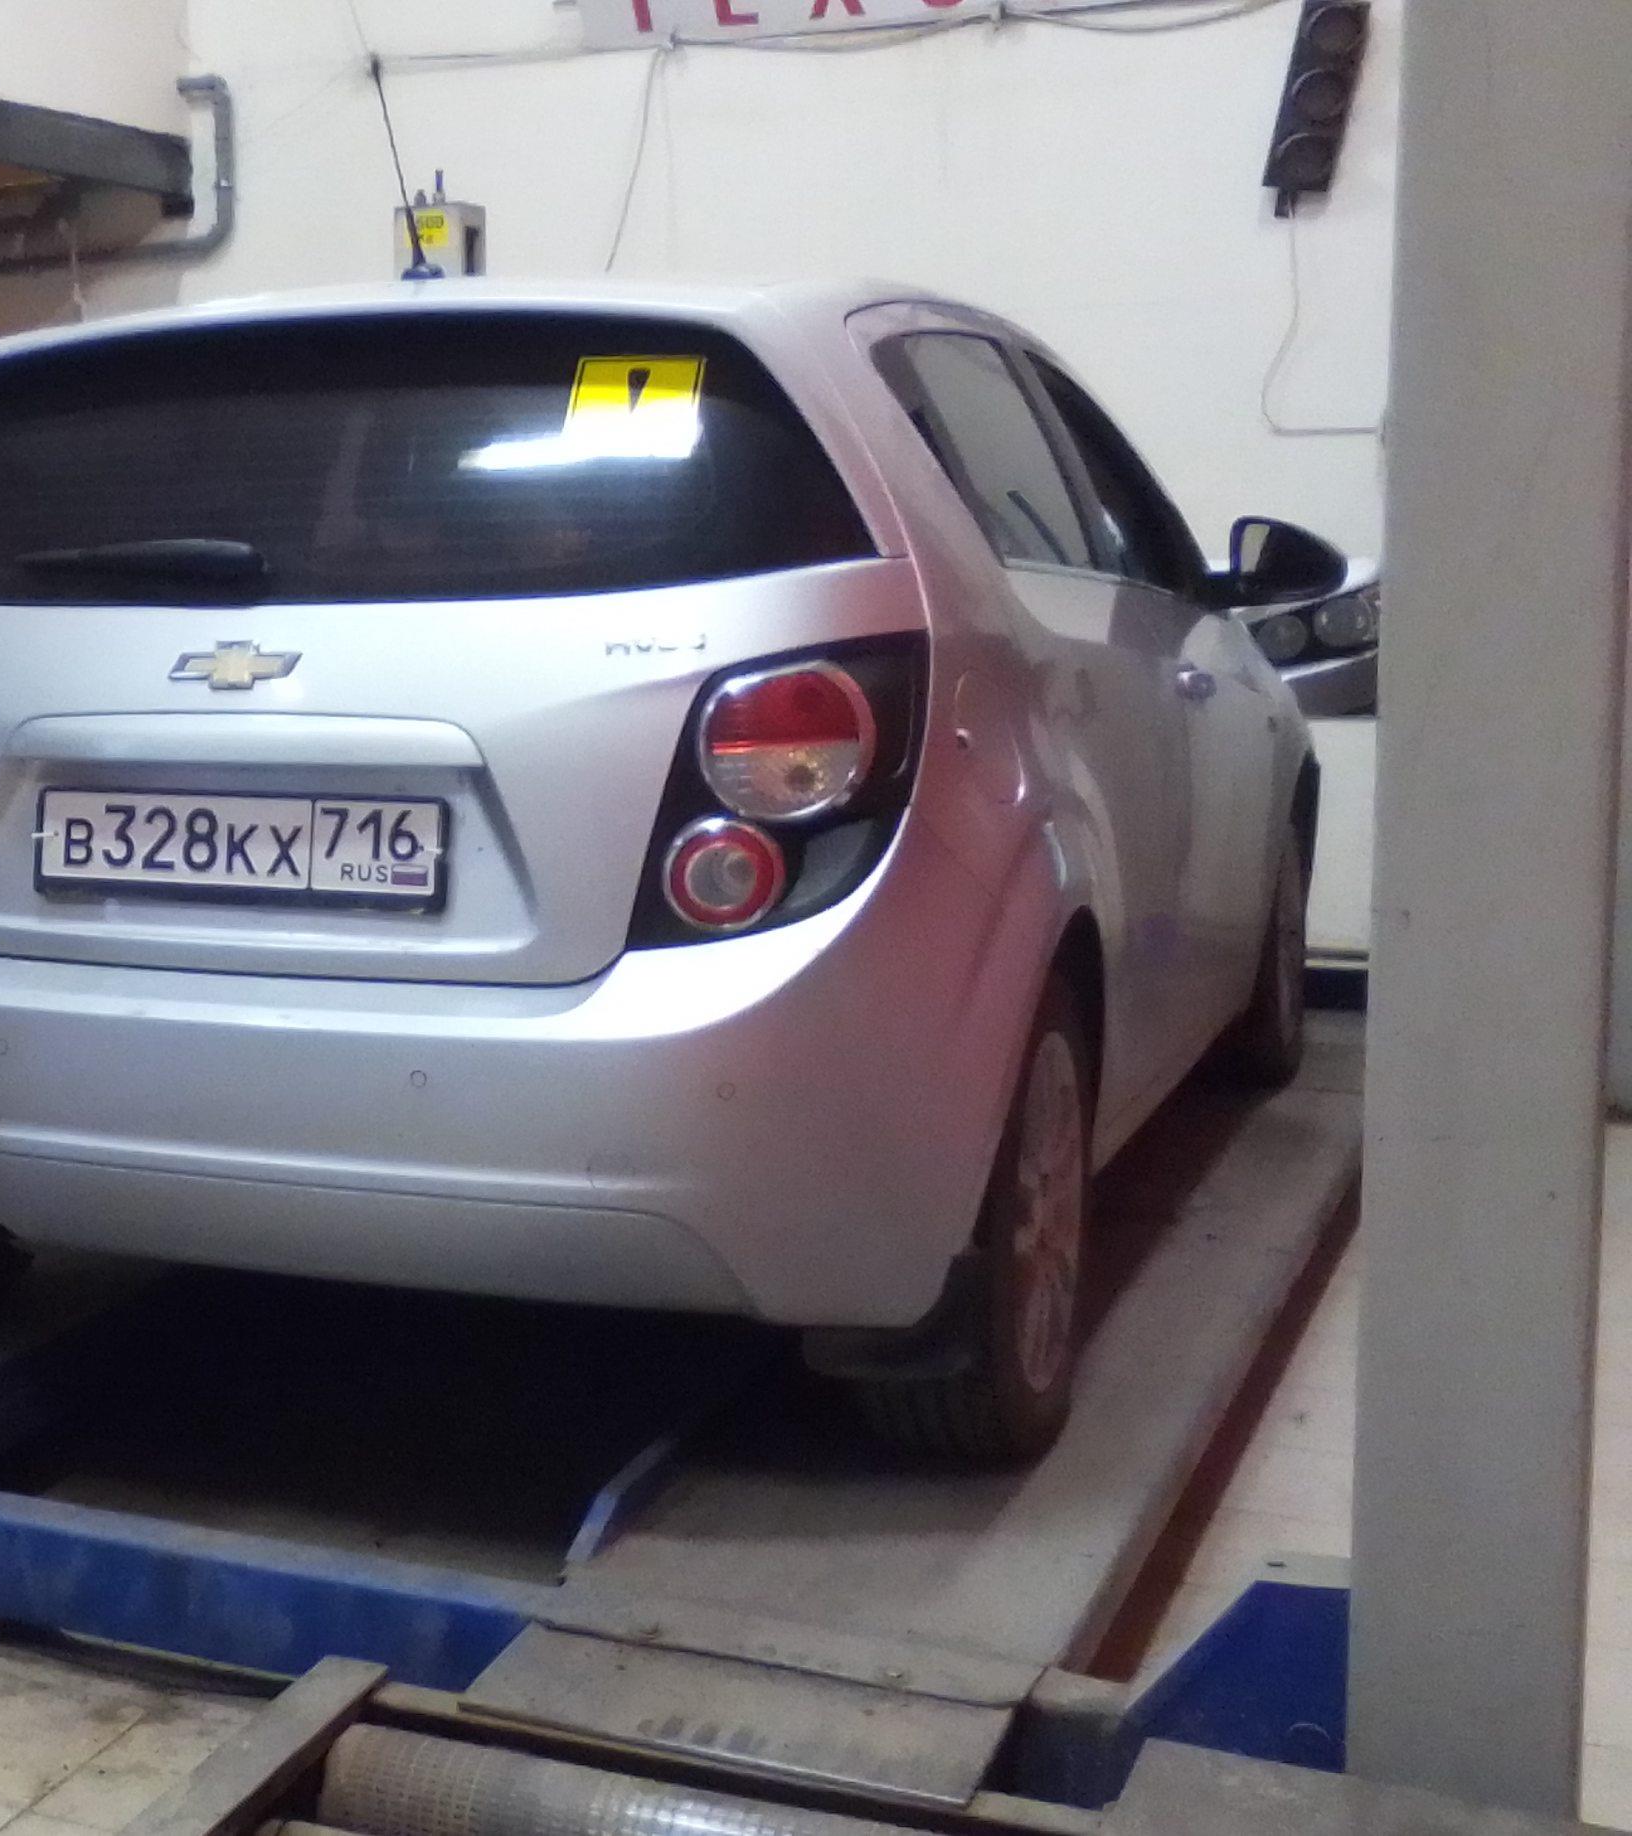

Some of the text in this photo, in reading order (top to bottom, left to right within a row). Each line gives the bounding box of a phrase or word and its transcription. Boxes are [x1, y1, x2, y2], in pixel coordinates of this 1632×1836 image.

[62, 803, 419, 878] B328KX 716
[340, 862, 389, 884] RUS
